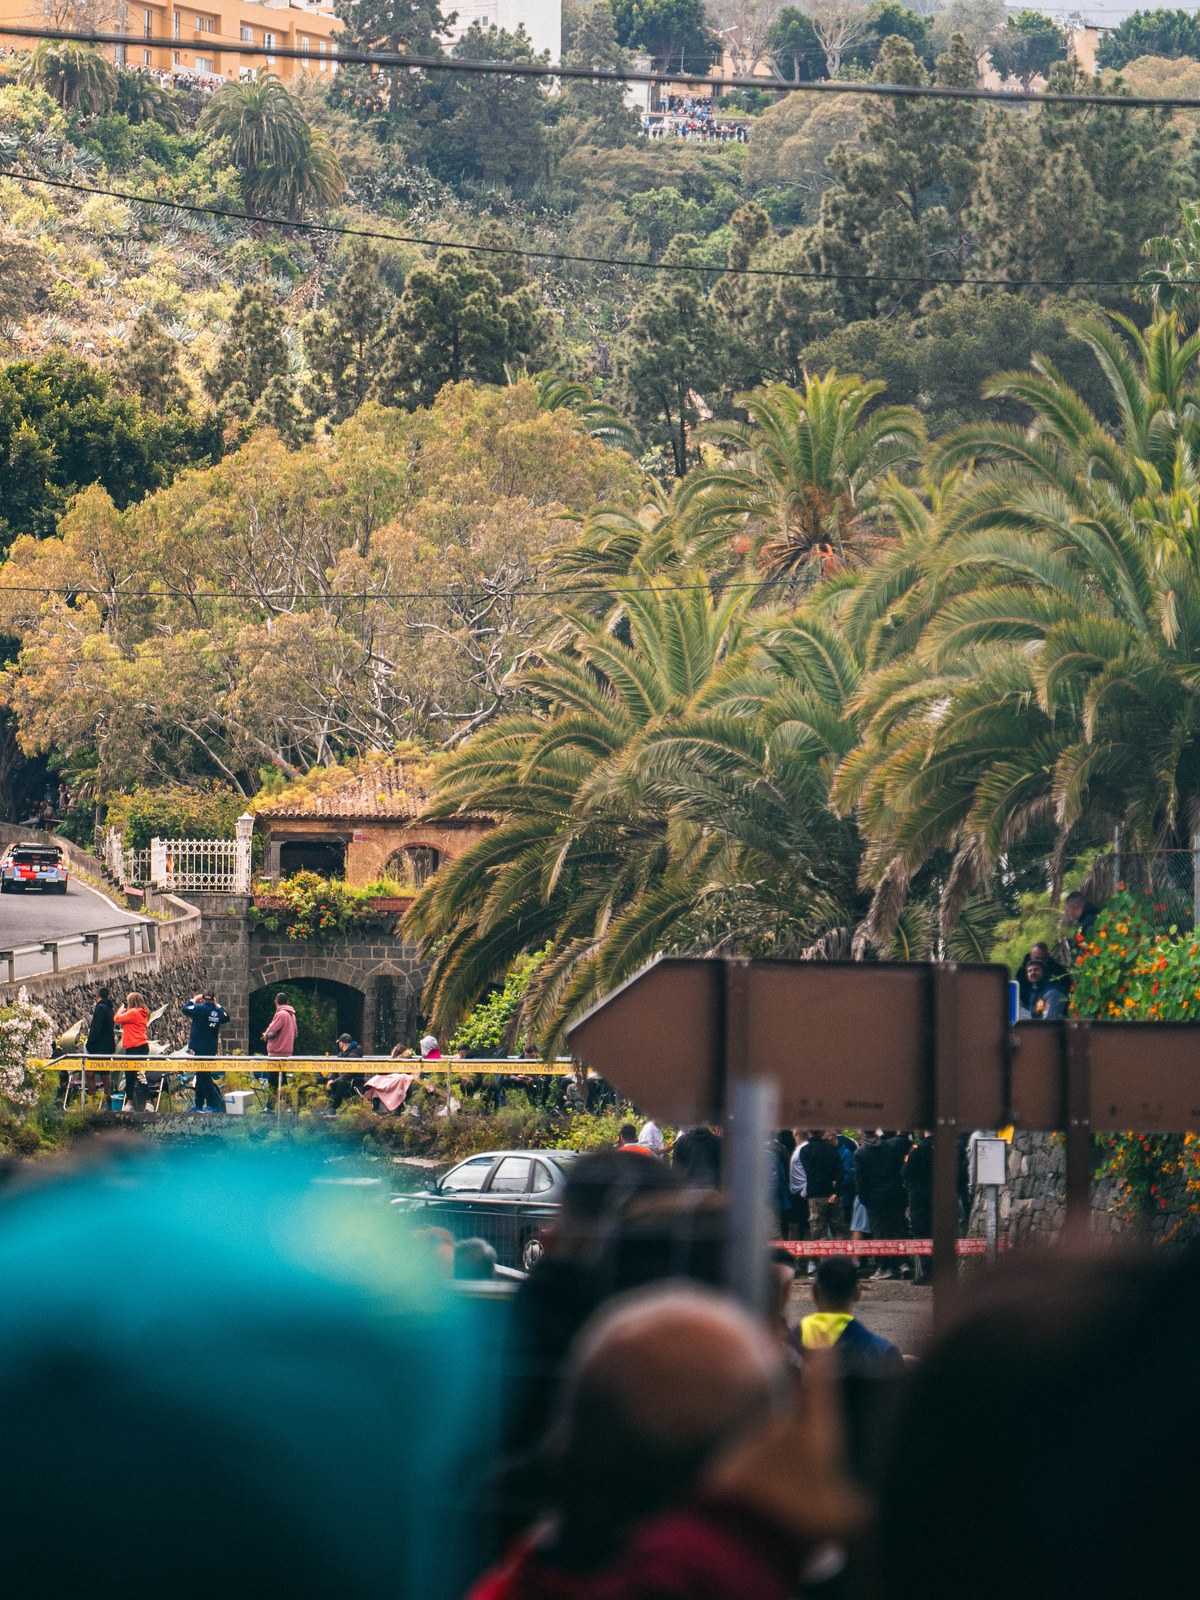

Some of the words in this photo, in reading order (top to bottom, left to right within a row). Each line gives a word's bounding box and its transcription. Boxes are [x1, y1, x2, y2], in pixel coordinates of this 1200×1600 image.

[89, 1061, 105, 1069] ZONA
[105, 1061, 129, 1069] PUBLICO
[133, 1061, 148, 1069] ZONA
[149, 1061, 173, 1069] PUBLICO
[177, 1061, 193, 1069] ZONA
[193, 1061, 217, 1069] PUBLICO
[238, 1062, 262, 1070] PUBLICO
[266, 1062, 282, 1070] ZONA
[282, 1062, 307, 1070] PUBLICO
[466, 1064, 492, 1072] PUBLICO
[496, 1064, 512, 1072] ZONA
